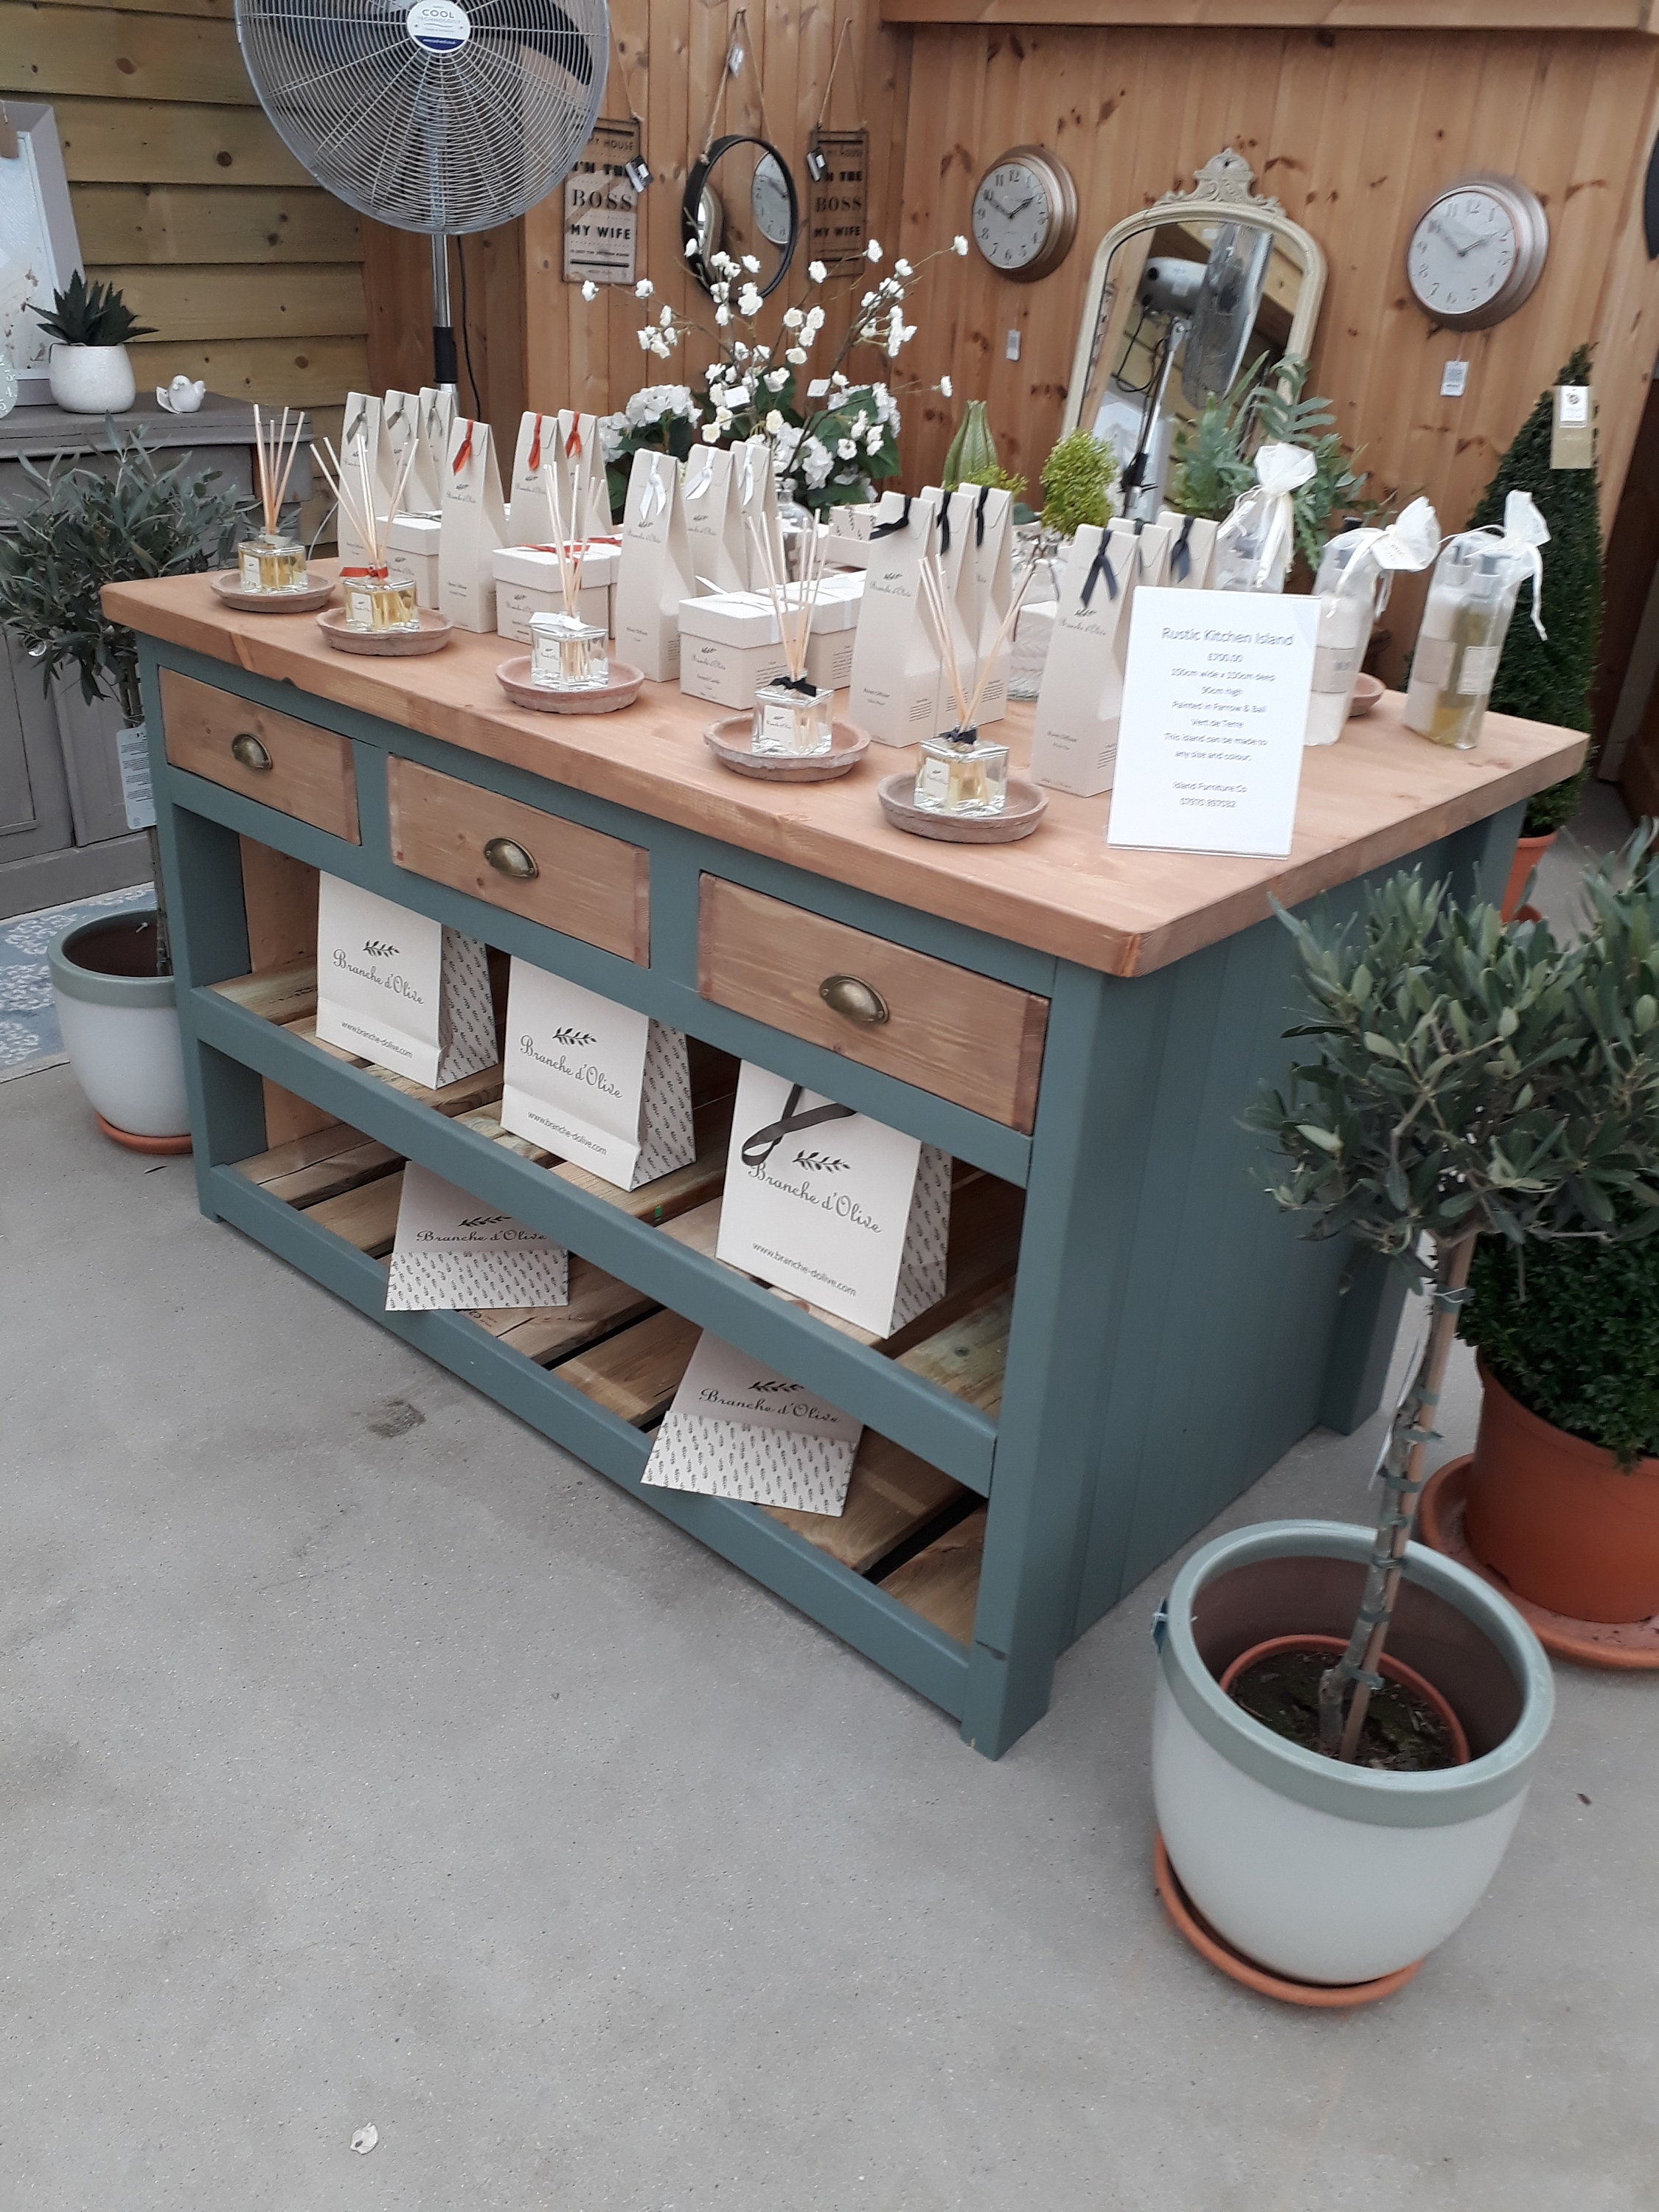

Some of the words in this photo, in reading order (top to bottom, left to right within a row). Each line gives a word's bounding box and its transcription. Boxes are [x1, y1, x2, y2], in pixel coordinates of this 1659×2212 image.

[422, 9, 455, 18] COOL
[603, 140, 635, 150] HOUSE
[602, 163, 628, 177] TH
[572, 189, 633, 211] BOSS
[815, 196, 862, 213] BOSS
[571, 223, 591, 237] MY
[597, 226, 631, 240] WIFE
[814, 227, 830, 237] MY
[835, 226, 861, 237] WIFE
[1163, 627, 1201, 641] Rustic
[1204, 630, 1252, 644] Kitchen
[1256, 633, 1295, 646] Island
[1200, 669, 1220, 678] wide
[1172, 700, 1203, 709] Painted
[1214, 703, 1241, 712] Farrow
[1164, 733, 1181, 741] This
[1183, 734, 1206, 742] island
[1172, 782, 1197, 790] Island
[1197, 783, 1235, 792] Furniture
[333, 948, 383, 985] Branche
[384, 973, 425, 1004] d'Olive
[341, 1020, 414, 1059] www.branche-dolive.com
[519, 1034, 574, 1076] Branche
[574, 1062, 624, 1099] d'Olive
[526, 1110, 608, 1156] www.branche-dolive.com
[747, 1161, 820, 1205] Branche
[821, 1191, 883, 1234] d'Olive
[416, 1229, 487, 1242] Branche
[490, 1228, 548, 1242] d'Olive
[751, 1242, 857, 1298] www.branche-dolive.com
[698, 1387, 775, 1413] Branche
[776, 1402, 841, 1424] d'Olive
